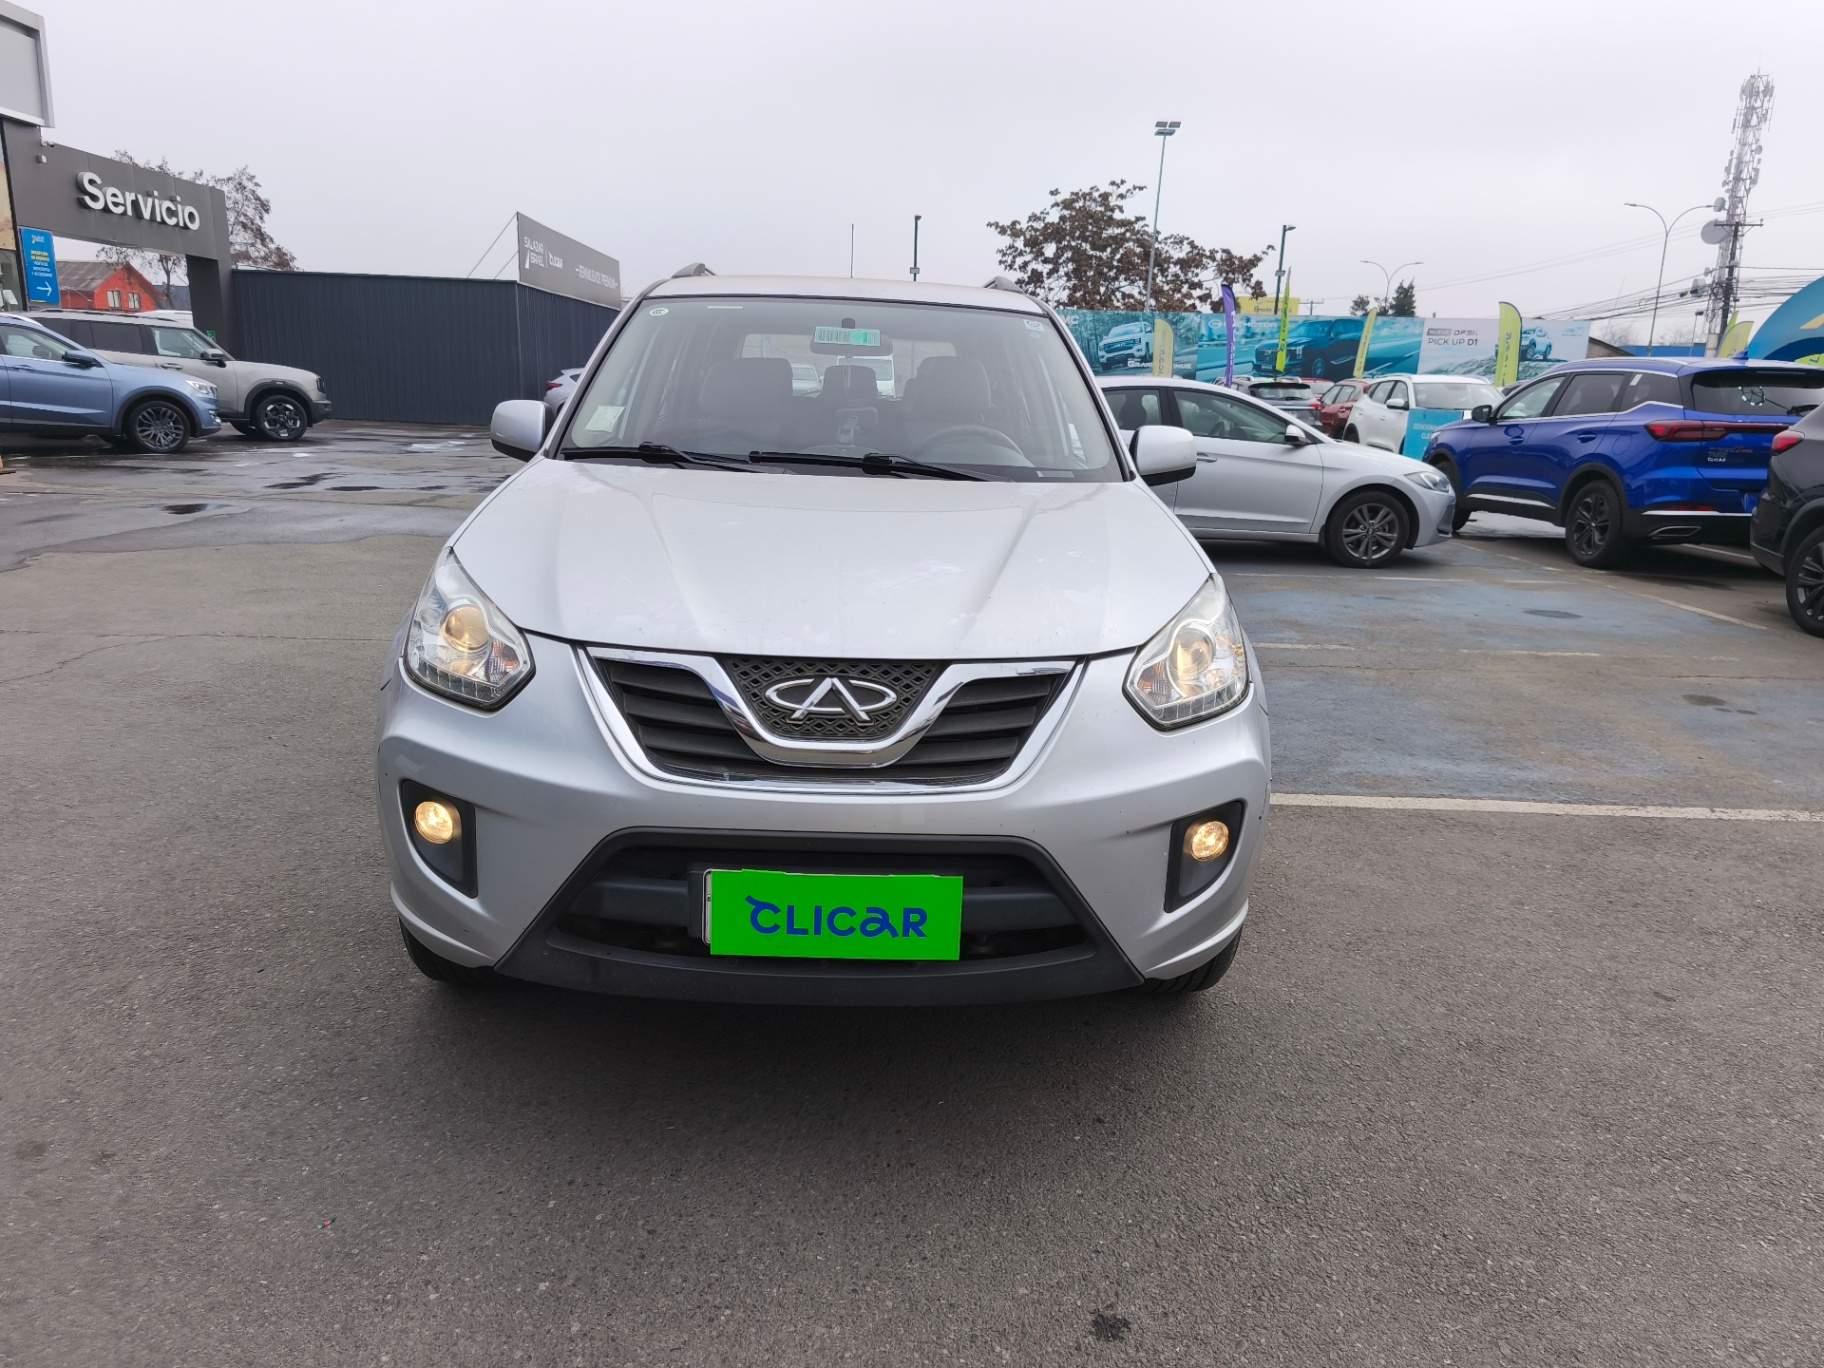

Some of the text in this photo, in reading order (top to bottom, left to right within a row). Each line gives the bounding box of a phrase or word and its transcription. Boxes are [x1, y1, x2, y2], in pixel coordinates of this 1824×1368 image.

[77, 171, 200, 231] Servicio
[1427, 337, 1449, 345] PICK
[1467, 338, 1478, 346] D1
